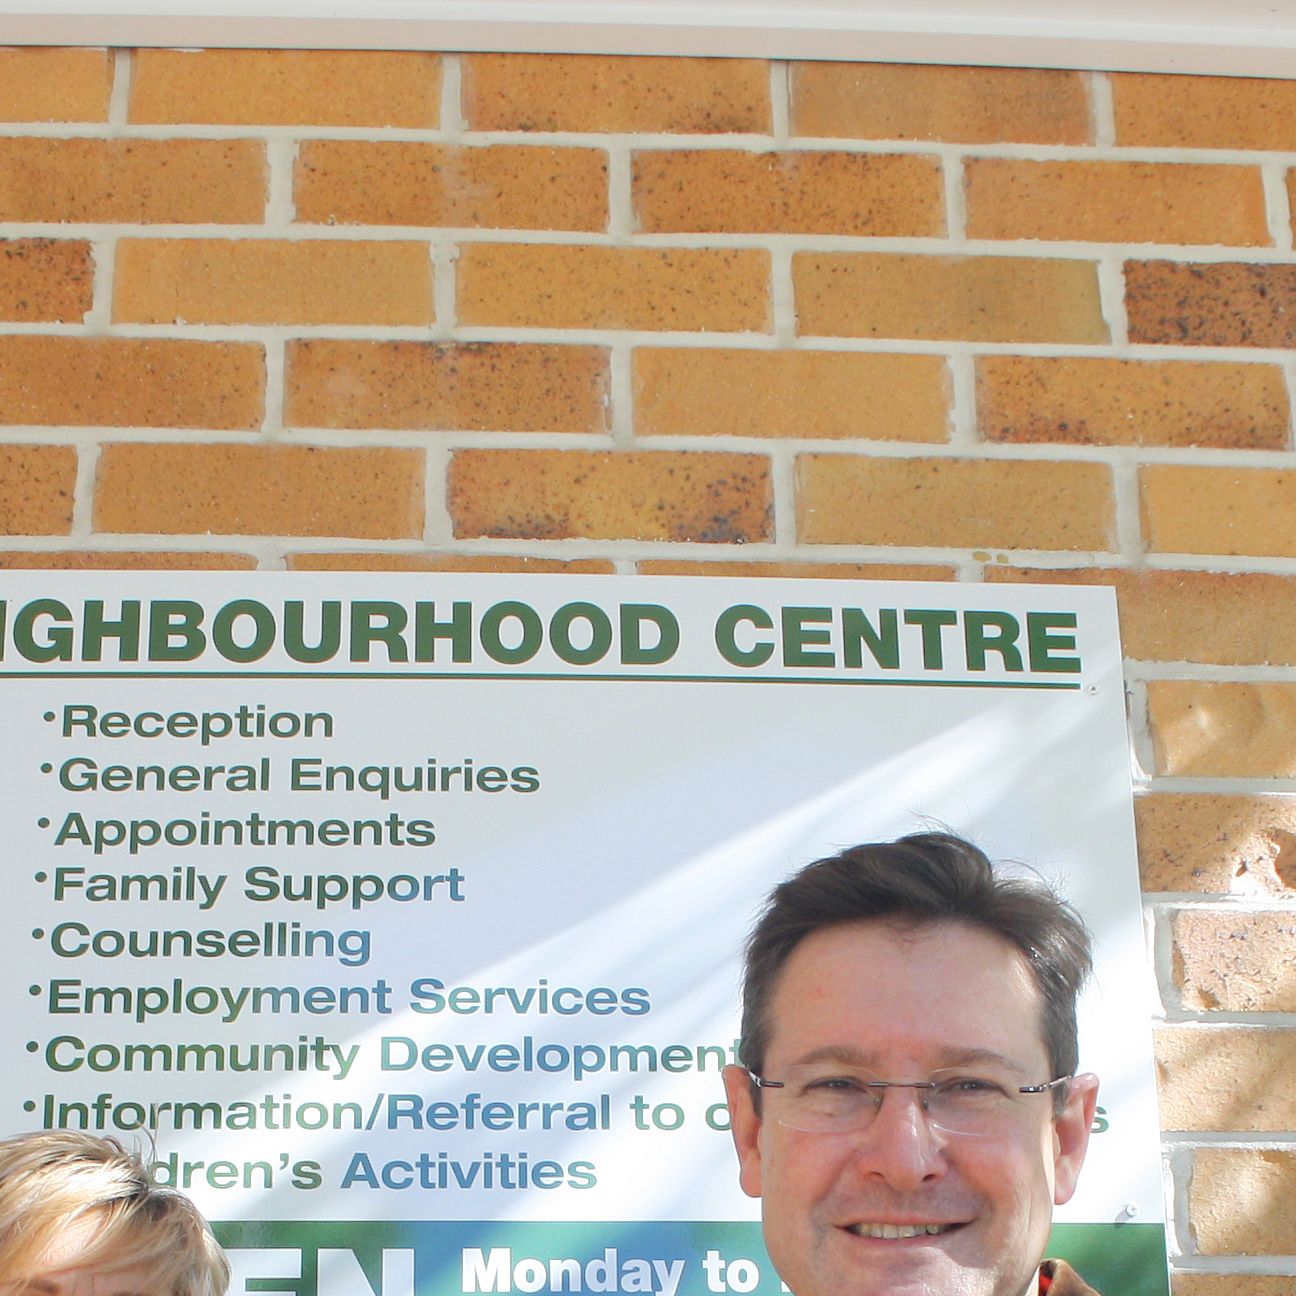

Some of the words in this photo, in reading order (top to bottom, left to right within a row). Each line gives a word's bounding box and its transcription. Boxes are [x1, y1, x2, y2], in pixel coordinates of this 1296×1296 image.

[714, 604, 1082, 674] CENTRE
[61, 704, 334, 747] Reception
[58, 757, 270, 793] General
[290, 758, 541, 803] Enquiries
[53, 812, 437, 856] Appointments
[52, 866, 228, 910] Family
[244, 866, 466, 910] Support
[49, 921, 372, 967] Counselling
[47, 978, 393, 1024] Employment
[409, 978, 651, 1016] Services
[43, 1035, 361, 1081] Community
[42, 1092, 610, 1132] Information/Referral
[629, 1095, 686, 1131] to
[152, 1151, 323, 1190] dren's
[339, 1151, 597, 1190] Activities
[702, 1249, 760, 1293] to
